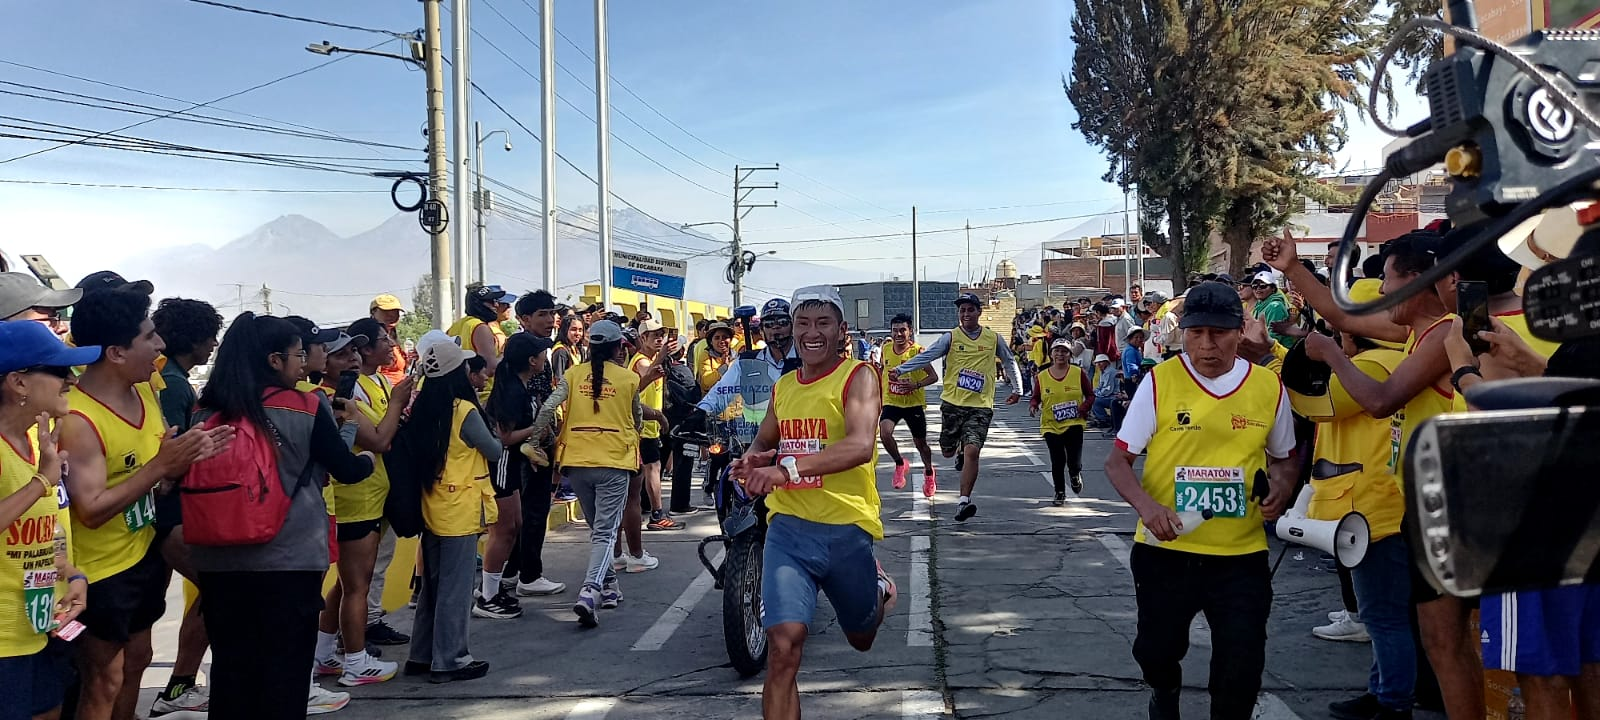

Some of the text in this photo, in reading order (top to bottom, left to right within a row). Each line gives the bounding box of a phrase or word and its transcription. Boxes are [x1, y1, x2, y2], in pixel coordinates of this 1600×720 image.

[614, 252, 682, 269] MUNICIPALIDAD DISTRITAL
[636, 263, 664, 273] SOCABAYA
[578, 384, 617, 394] SOCAYA
[959, 375, 982, 391] 0829
[1056, 407, 1076, 421] 2258
[1187, 467, 1231, 478] MARATÓN
[1176, 491, 1184, 507] 10K
[1184, 486, 1238, 513] 2453
[23, 561, 34, 570] UN
